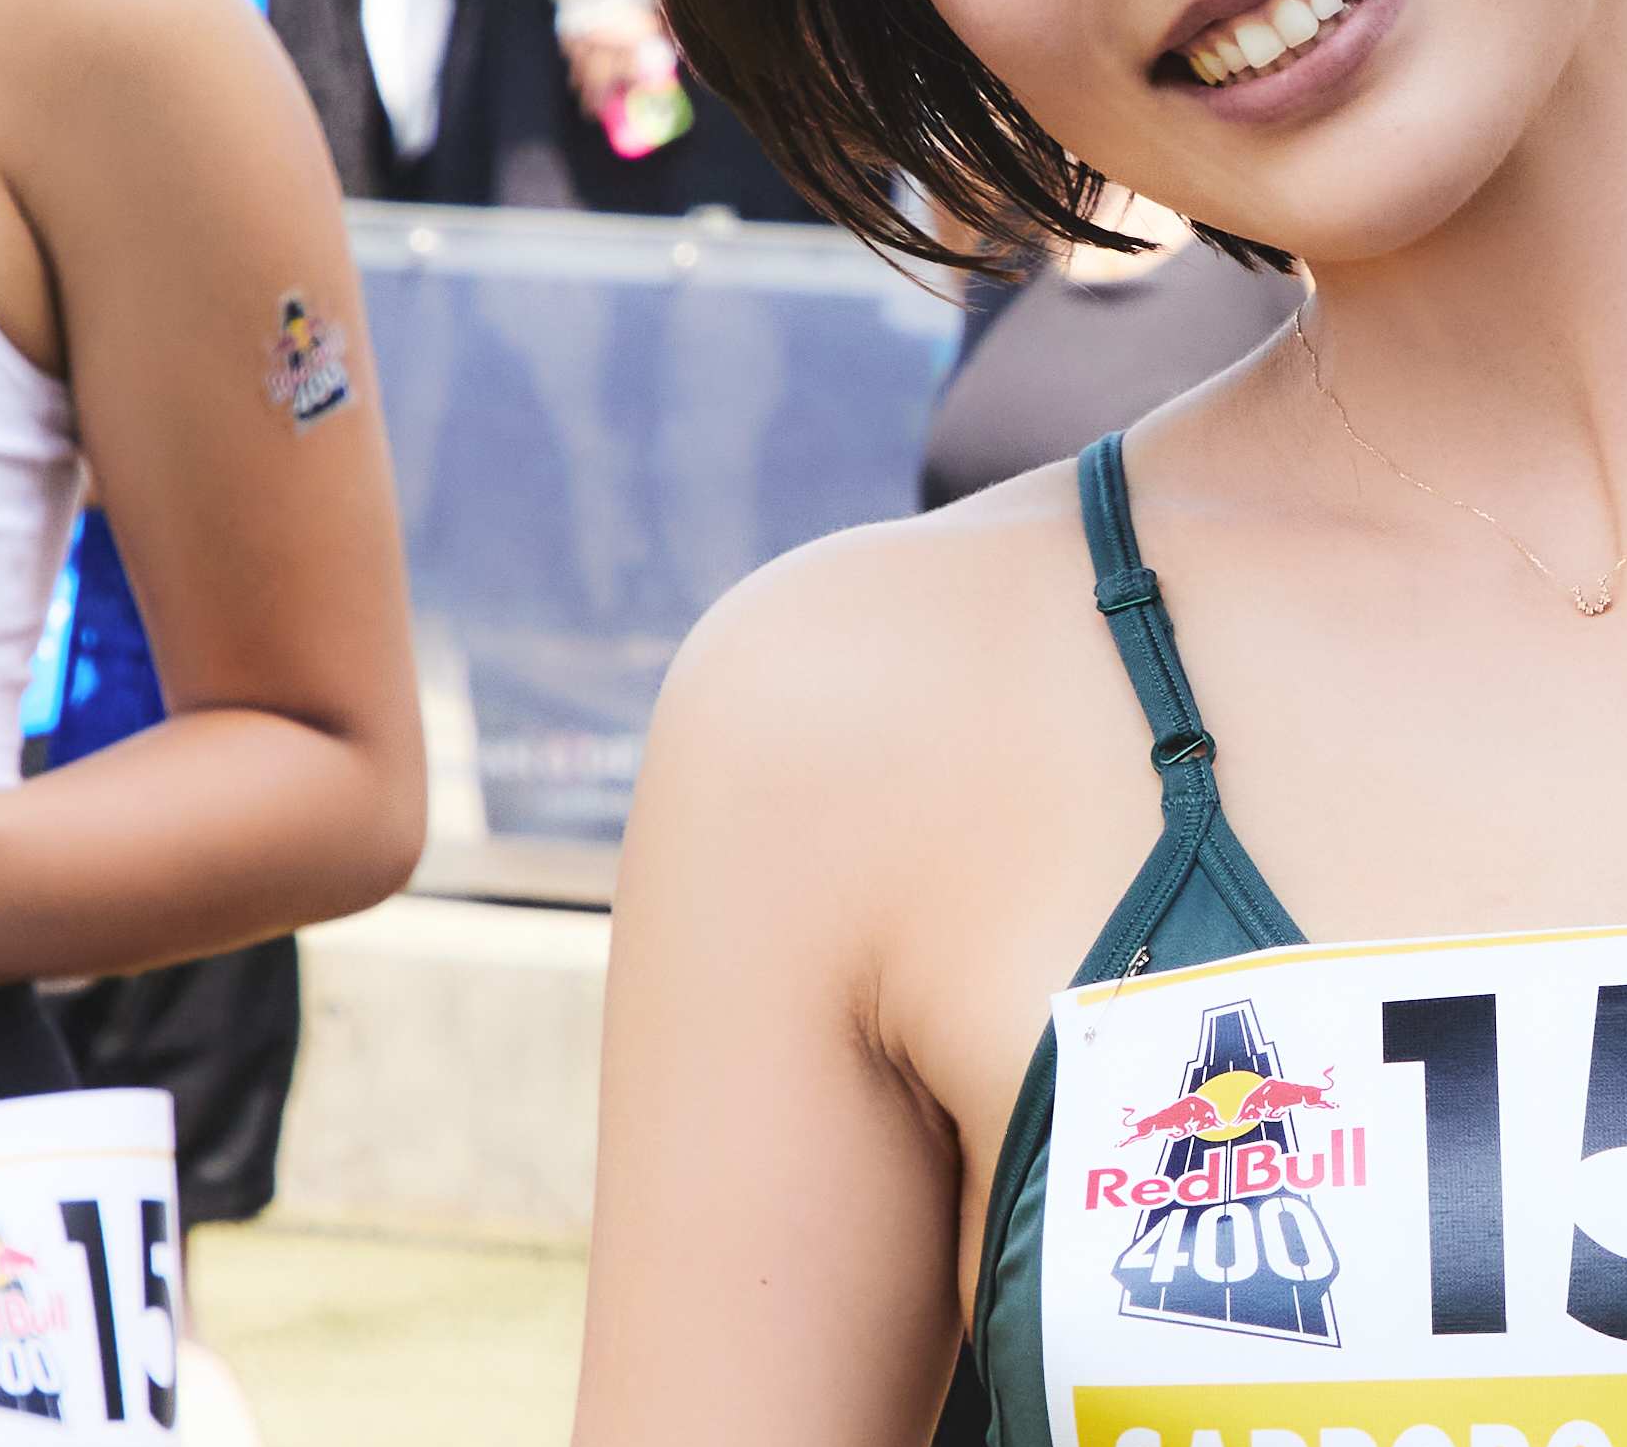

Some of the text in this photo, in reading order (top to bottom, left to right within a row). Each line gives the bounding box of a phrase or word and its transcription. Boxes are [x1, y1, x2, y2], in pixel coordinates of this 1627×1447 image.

[1084, 1127, 1367, 1210] Red Bull
[1117, 1196, 1336, 1284] 400
[3, 1290, 70, 1337] Bull
